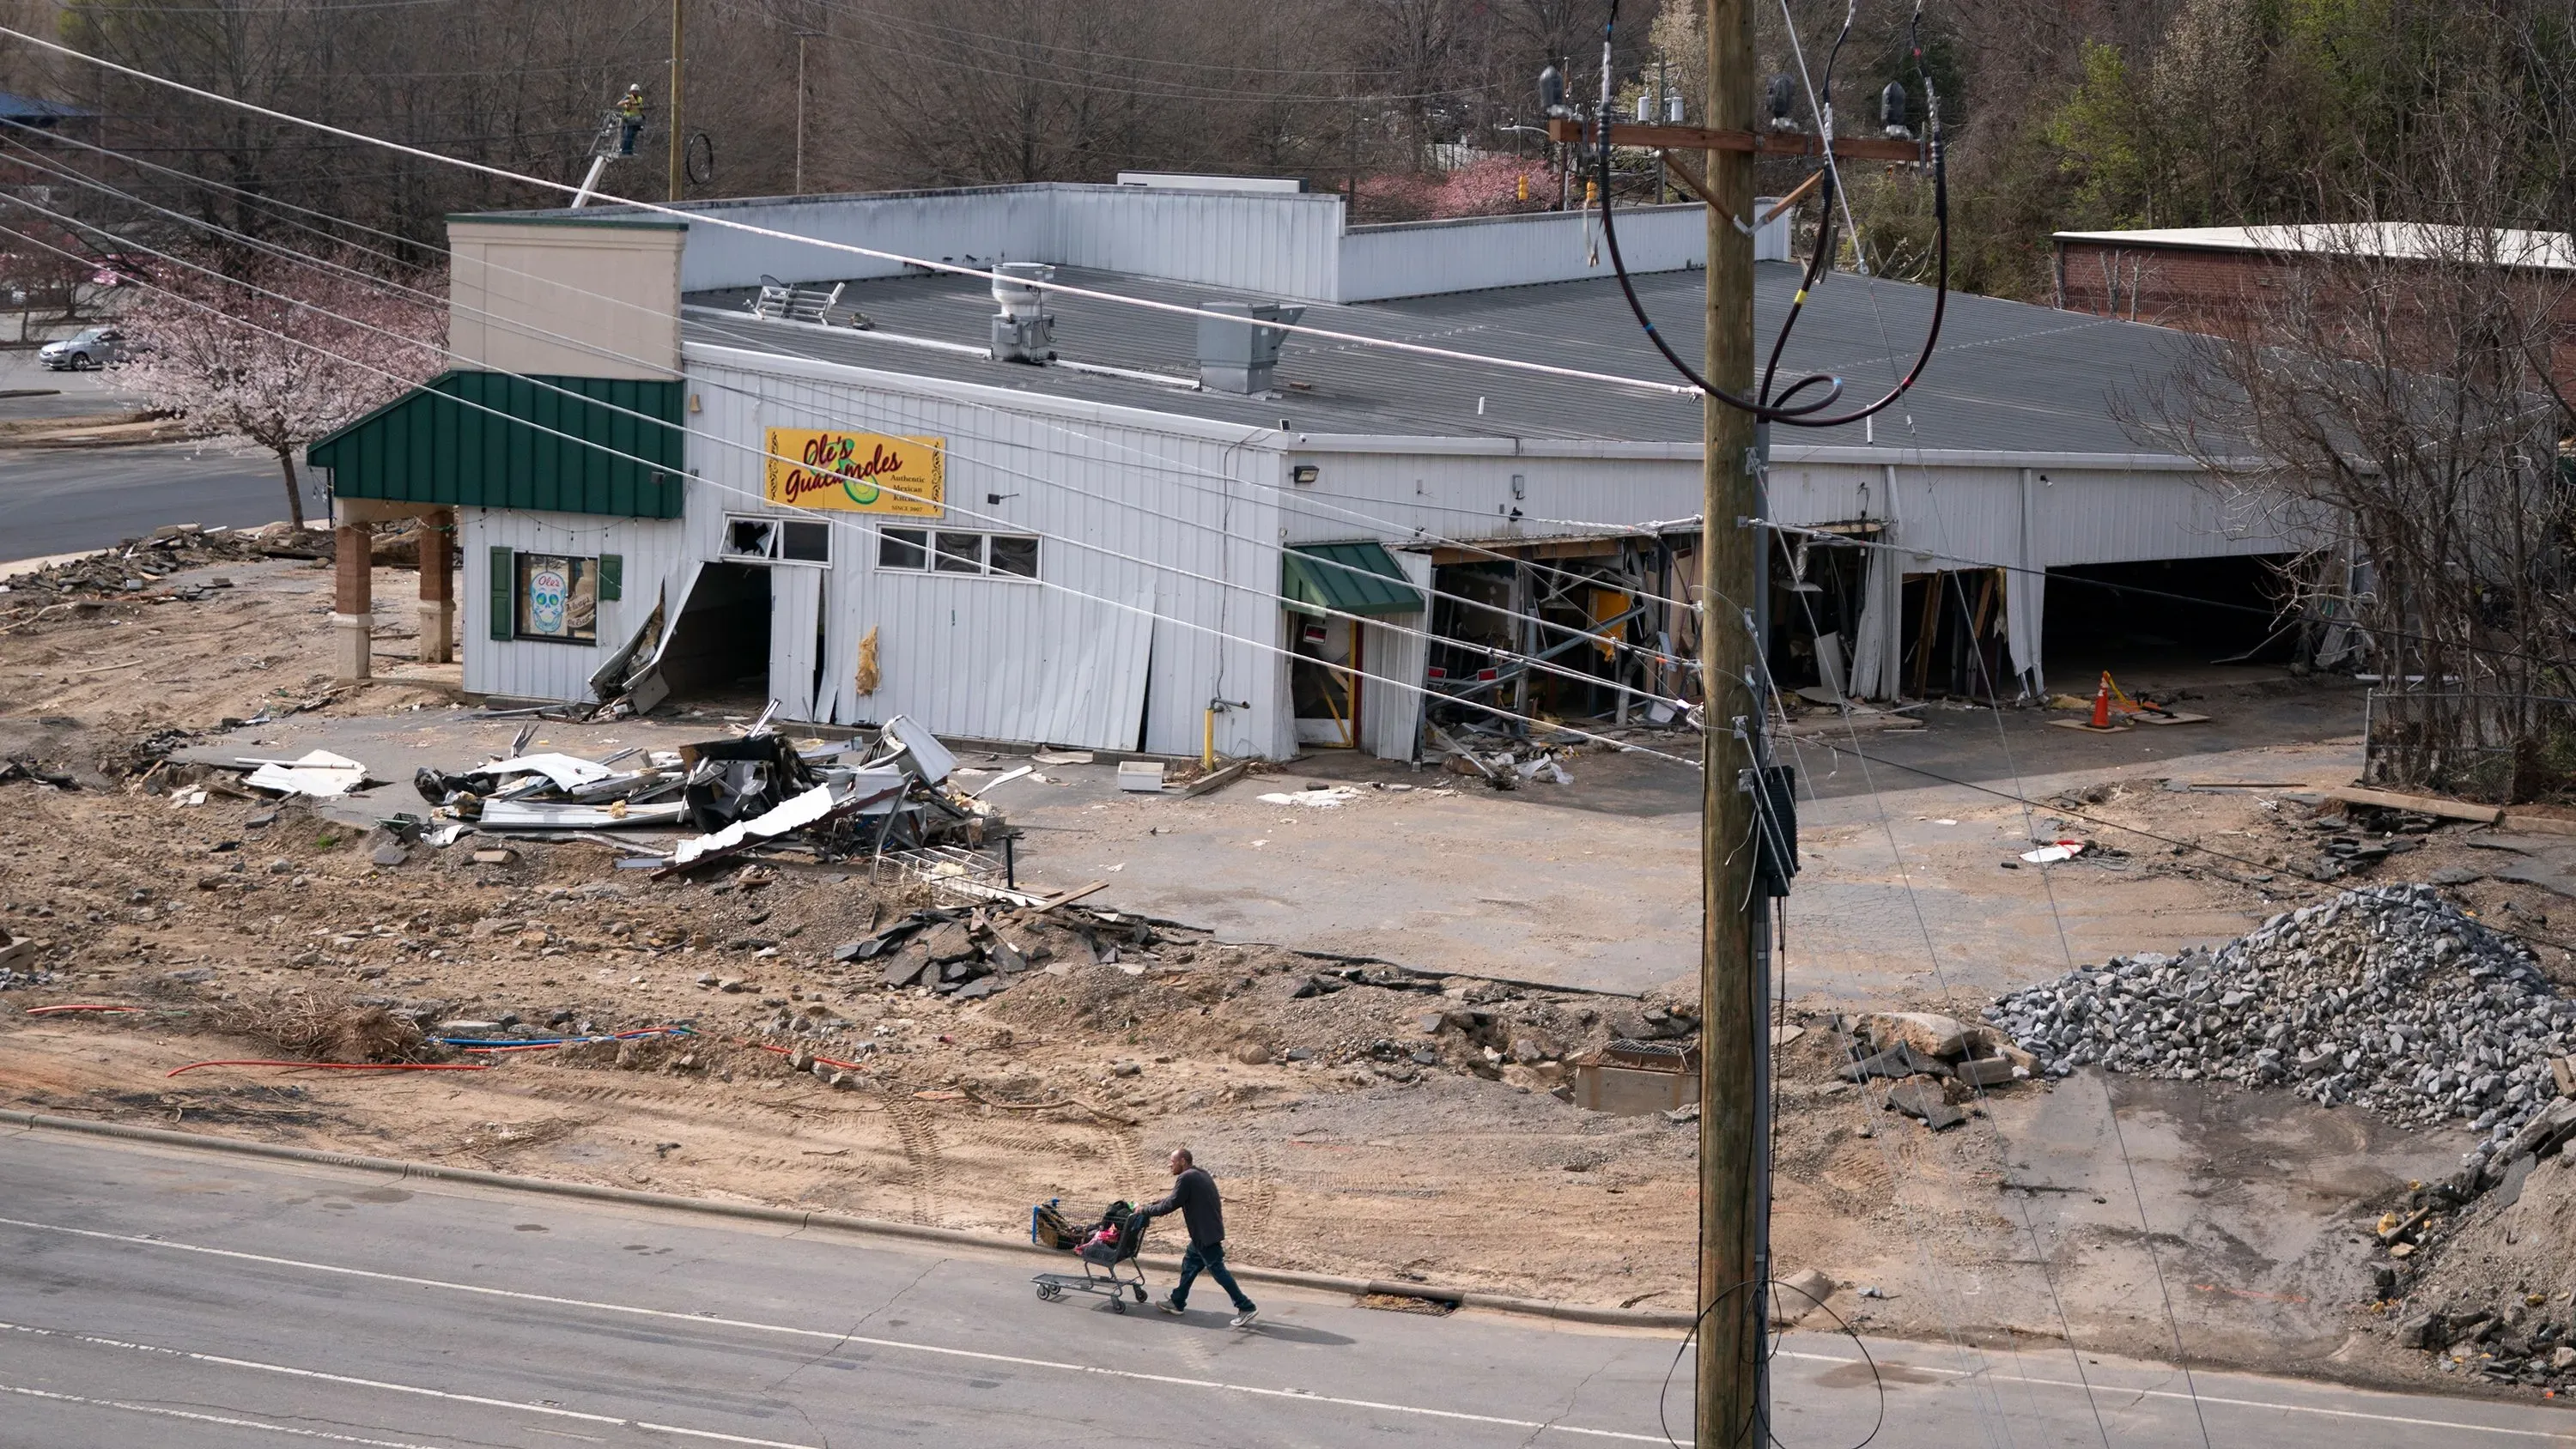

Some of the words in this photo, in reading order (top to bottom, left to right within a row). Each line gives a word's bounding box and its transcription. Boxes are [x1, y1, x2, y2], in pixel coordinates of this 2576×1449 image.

[803, 433, 854, 466] Ole's
[890, 474, 926, 483] Authentic
[893, 484, 923, 494] Mexican
